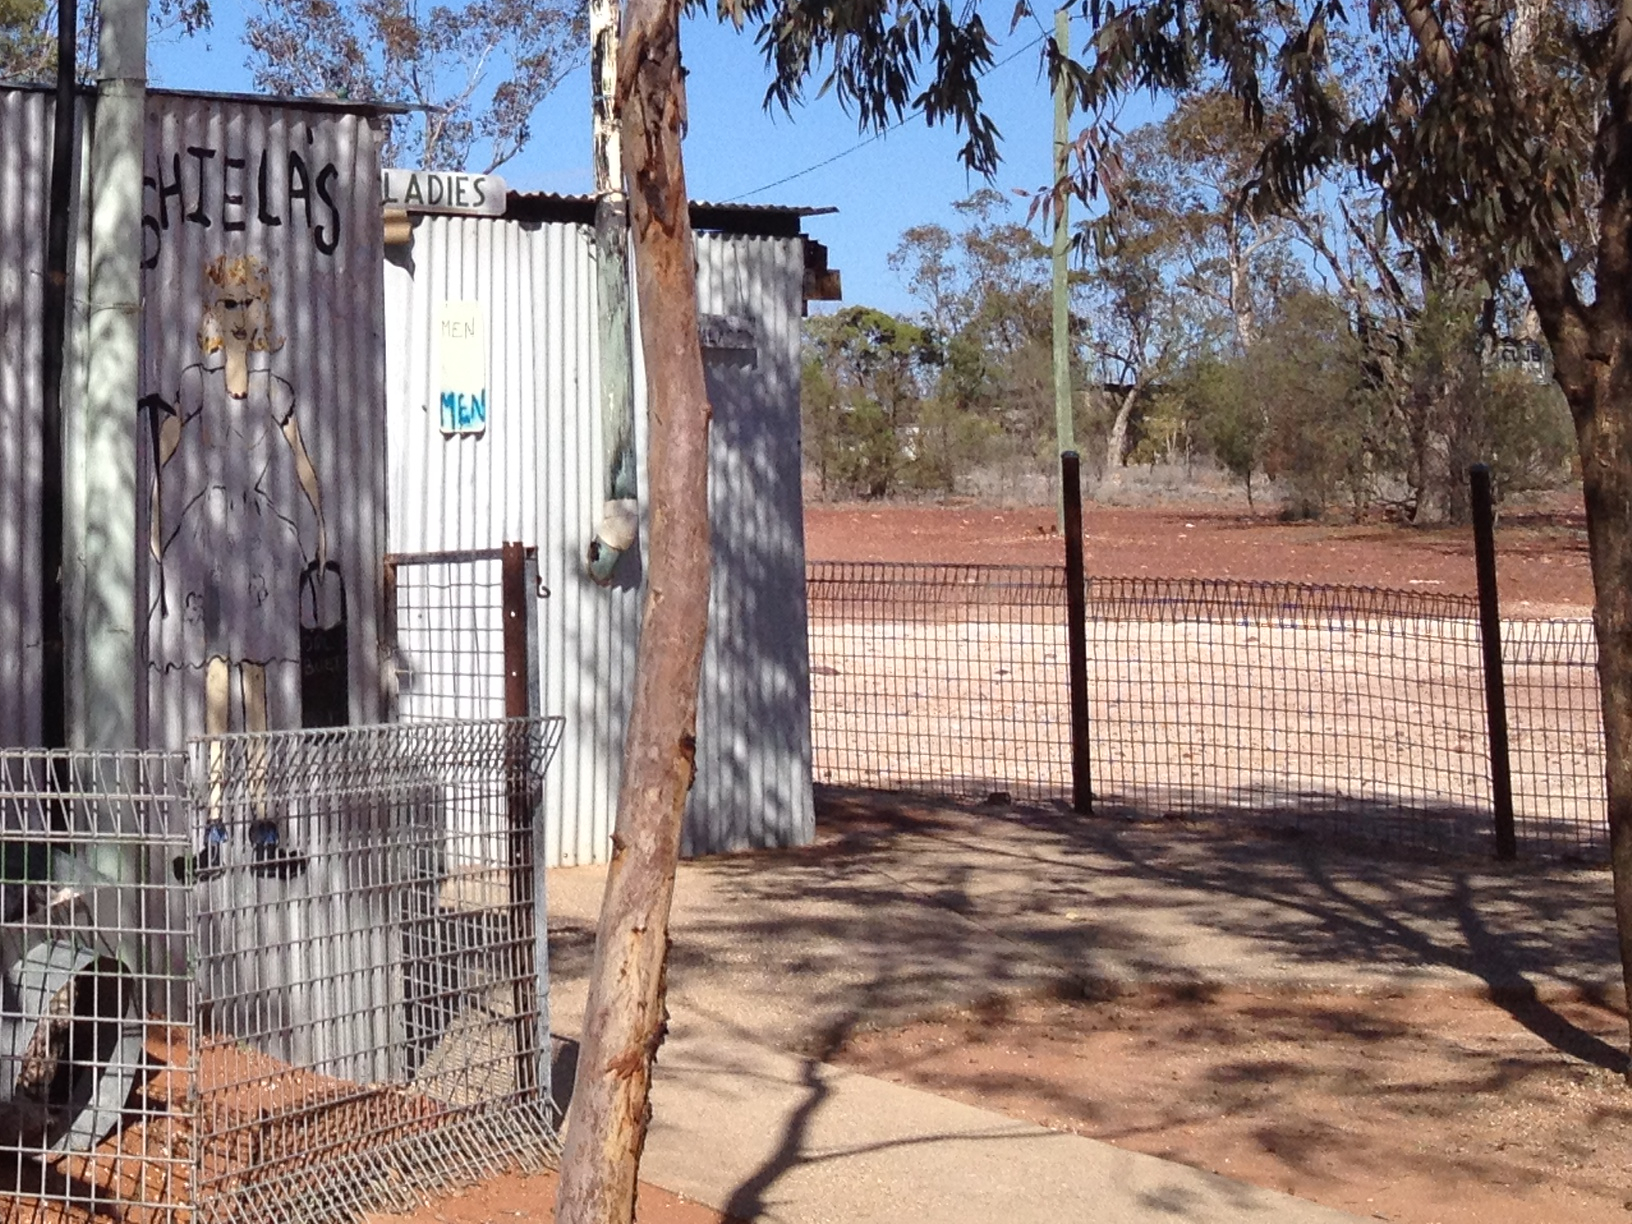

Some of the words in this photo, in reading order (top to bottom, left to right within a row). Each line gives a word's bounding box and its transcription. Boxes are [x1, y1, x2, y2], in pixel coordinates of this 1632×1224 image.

[382, 172, 488, 208] LADIES
[441, 317, 475, 339] MEN
[439, 388, 486, 432] MEN
